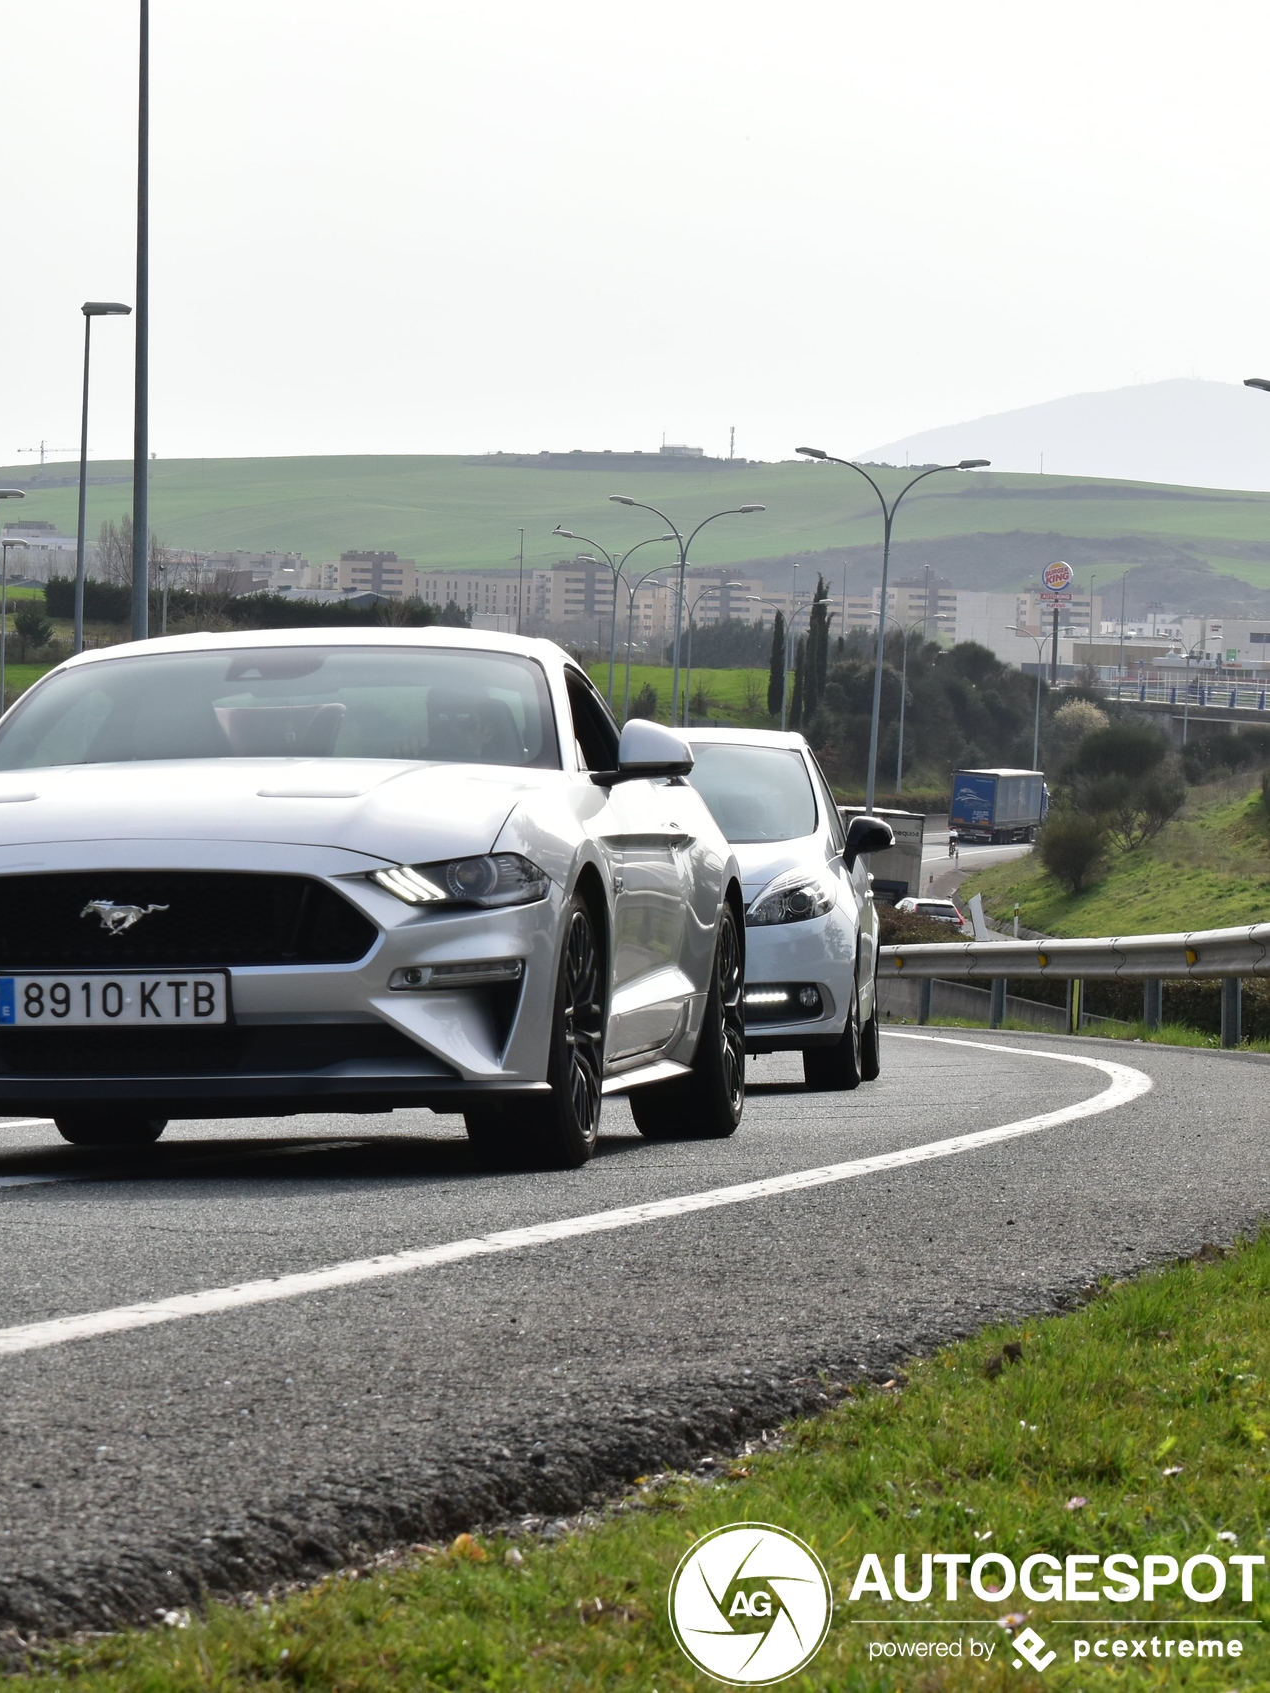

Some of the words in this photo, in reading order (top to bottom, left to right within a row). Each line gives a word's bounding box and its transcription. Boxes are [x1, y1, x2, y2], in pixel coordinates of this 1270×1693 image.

[1045, 567, 1069, 577] BURGER
[1045, 572, 1070, 584] KING
[23, 981, 124, 1019] 8910
[139, 981, 216, 1018] KTB
[2, 1006, 11, 1016] E
